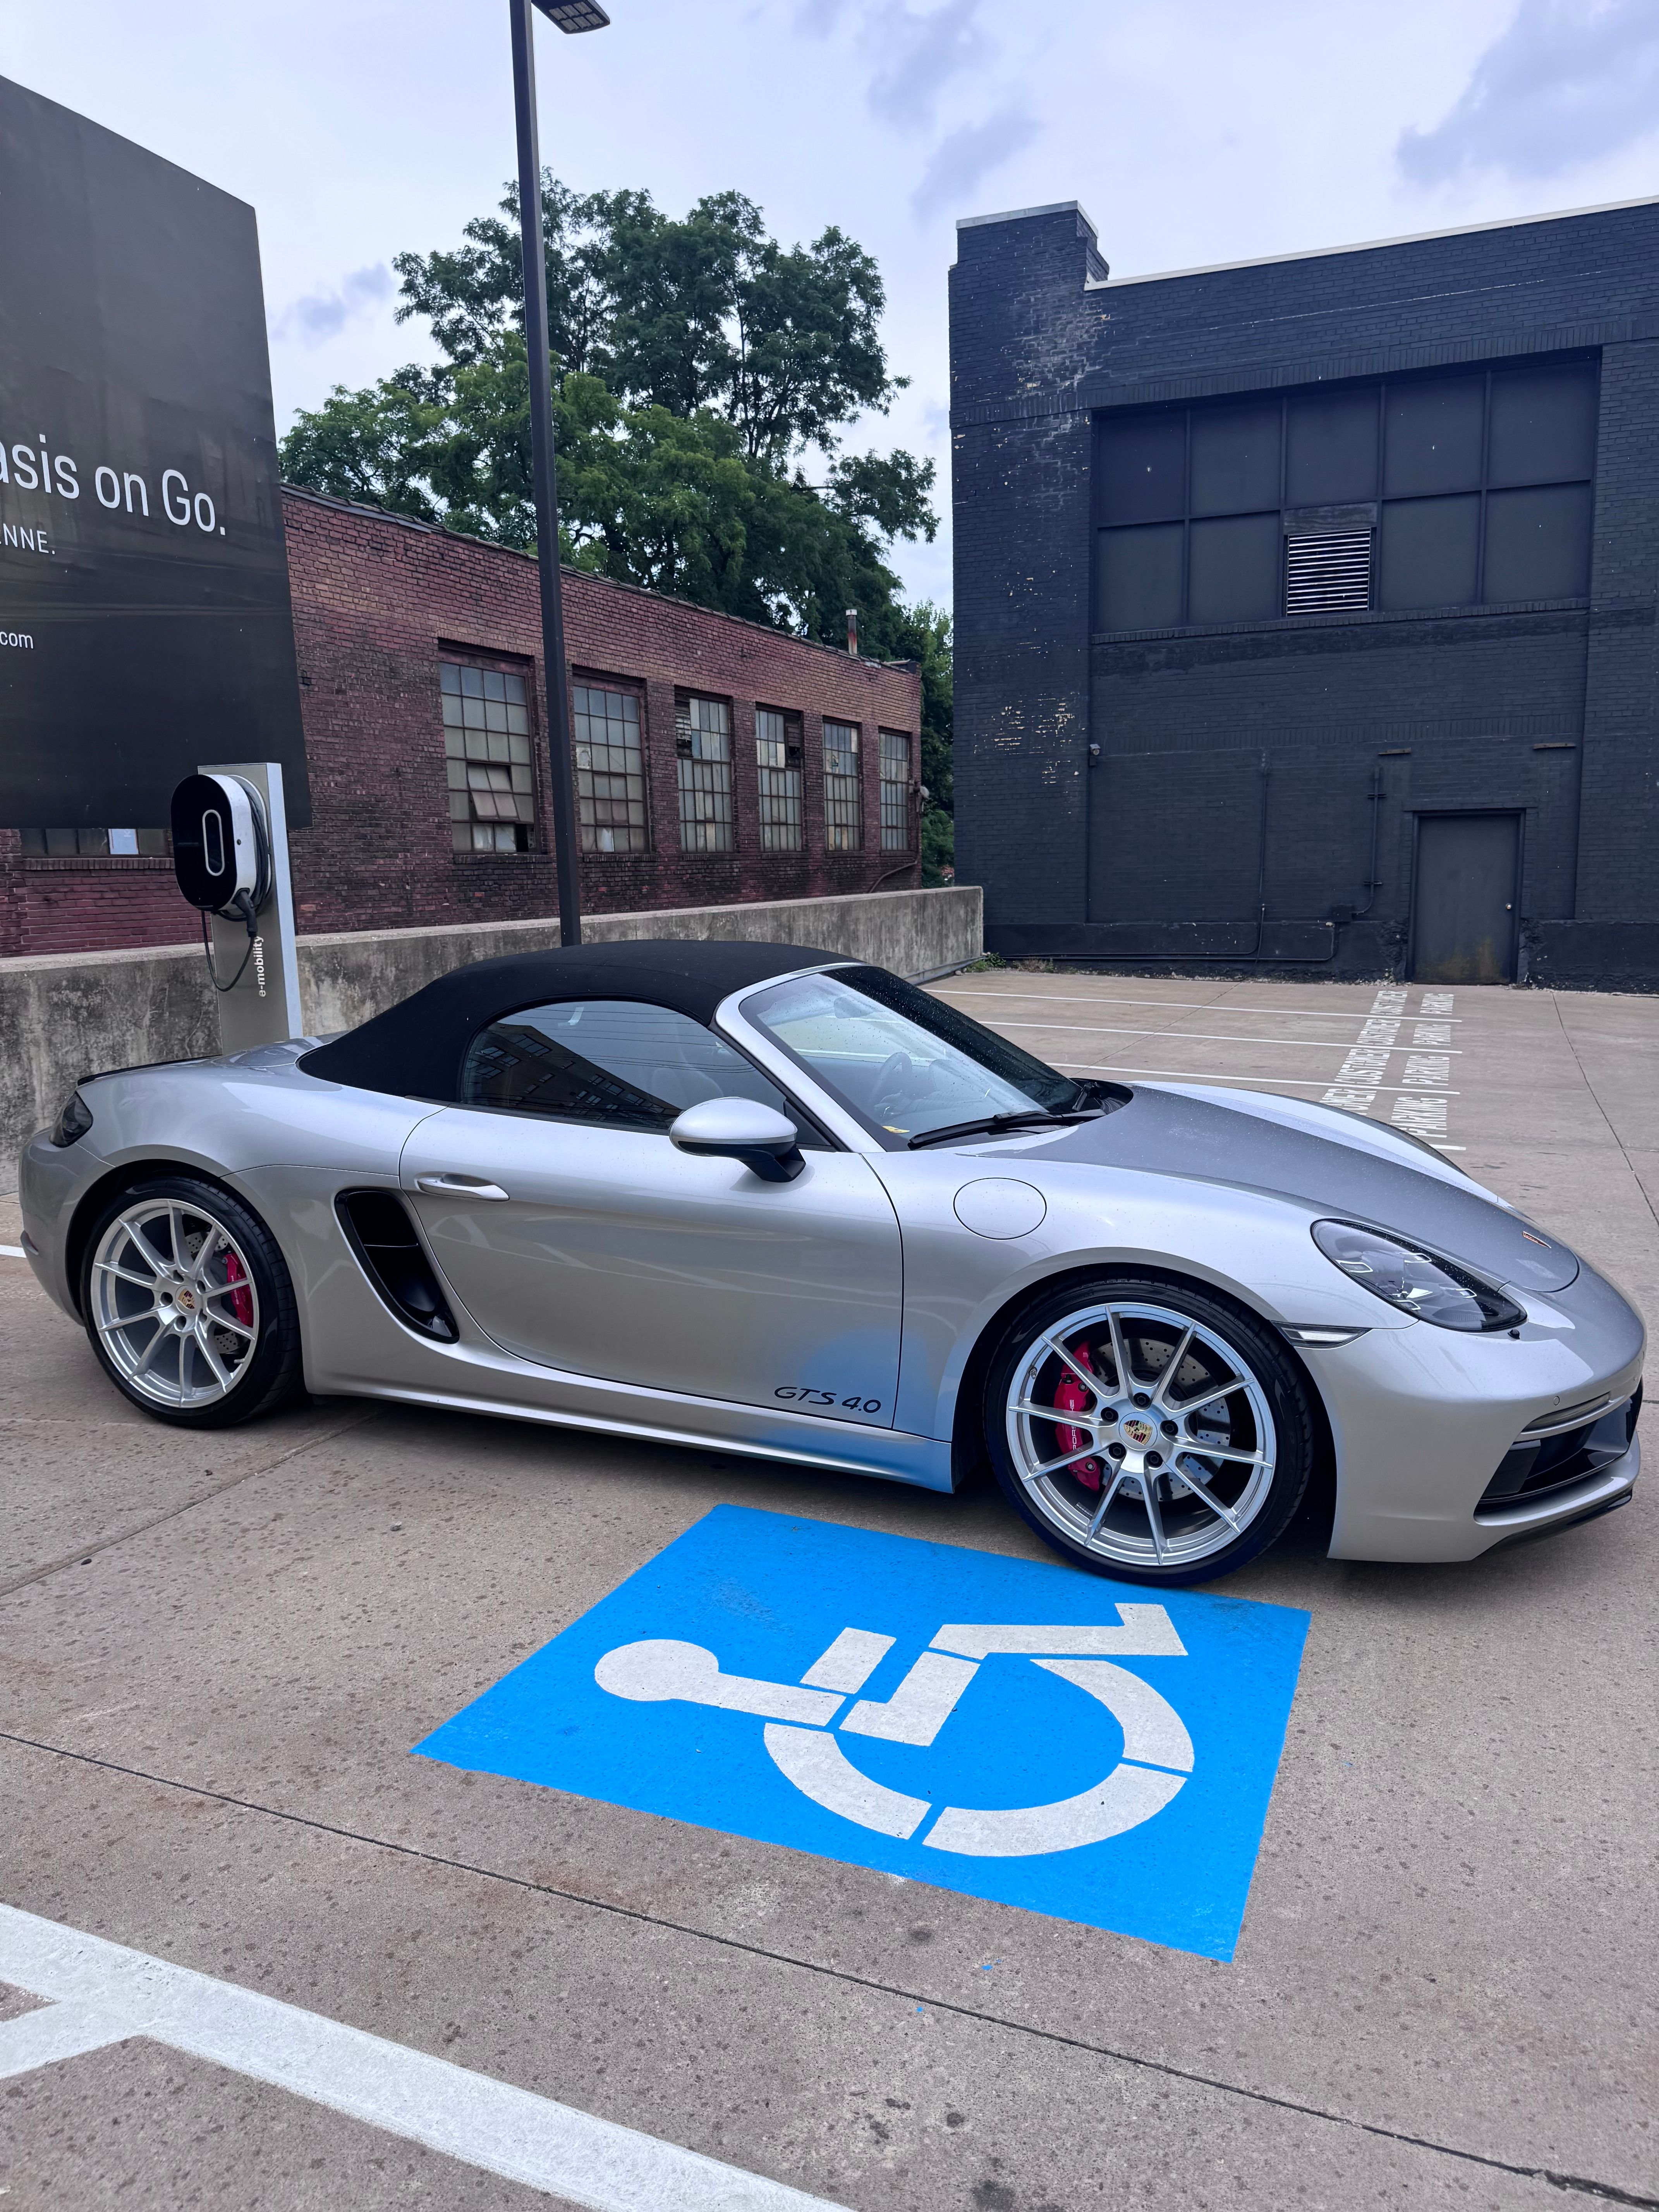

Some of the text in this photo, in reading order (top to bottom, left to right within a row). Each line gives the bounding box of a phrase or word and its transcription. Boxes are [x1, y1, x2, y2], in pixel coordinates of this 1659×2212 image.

[95, 467, 149, 516] on
[162, 469, 225, 535] Go.
[0, 524, 55, 554] NNE.
[252, 936, 266, 997] e-mobility
[1370, 991, 1408, 1015] CUSTOMER
[1420, 993, 1454, 1014] PARKING
[1356, 1019, 1401, 1045] CUSTOMER
[1413, 1024, 1451, 1045] PARKING
[1334, 1049, 1390, 1084] CUSTOMER
[1402, 1055, 1450, 1085] PARKING
[1390, 1097, 1447, 1137] PARKING
[774, 1386, 881, 1413] GTS 4.0
